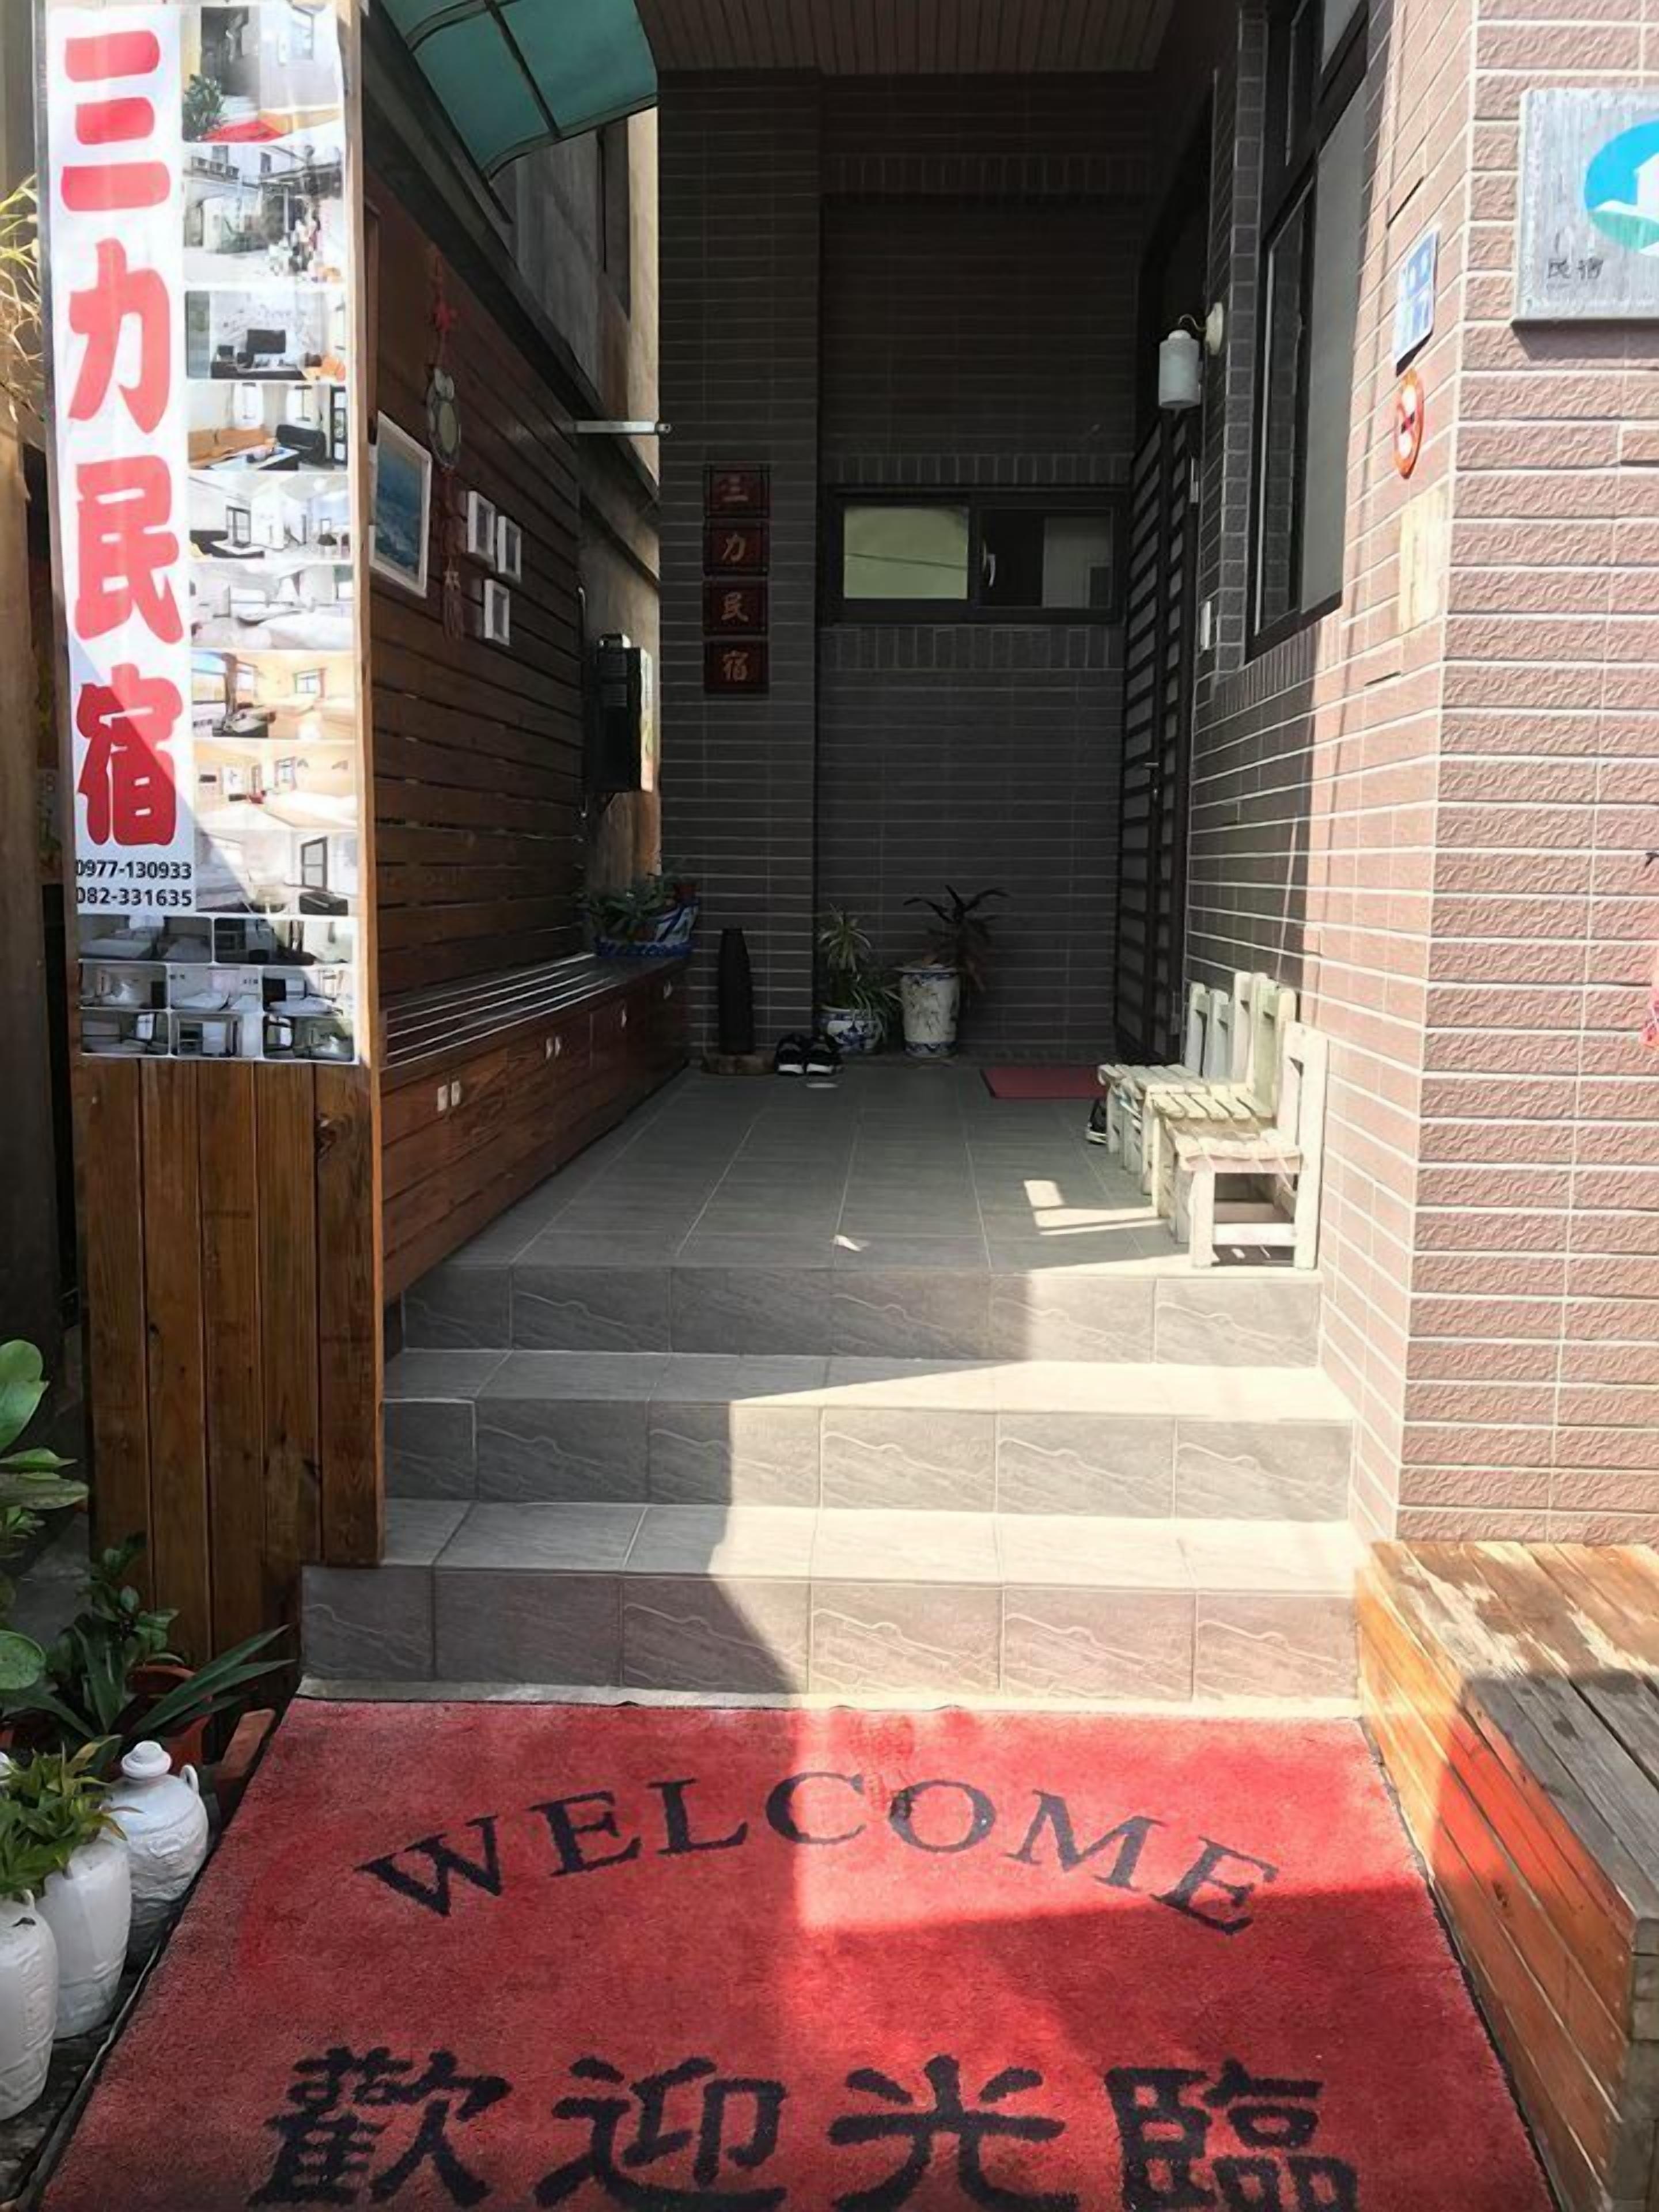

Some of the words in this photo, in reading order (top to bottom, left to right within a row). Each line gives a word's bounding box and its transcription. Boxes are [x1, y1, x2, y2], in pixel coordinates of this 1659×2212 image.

[61, 29, 184, 846] 三力民宿
[721, 475, 749, 683] 三力民宿
[76, 859, 192, 880] 0977-130933
[76, 887, 192, 907] 082-331635
[351, 1771, 1278, 1936] WELCOME
[245, 2046, 1358, 2212] 歡迎光臨
